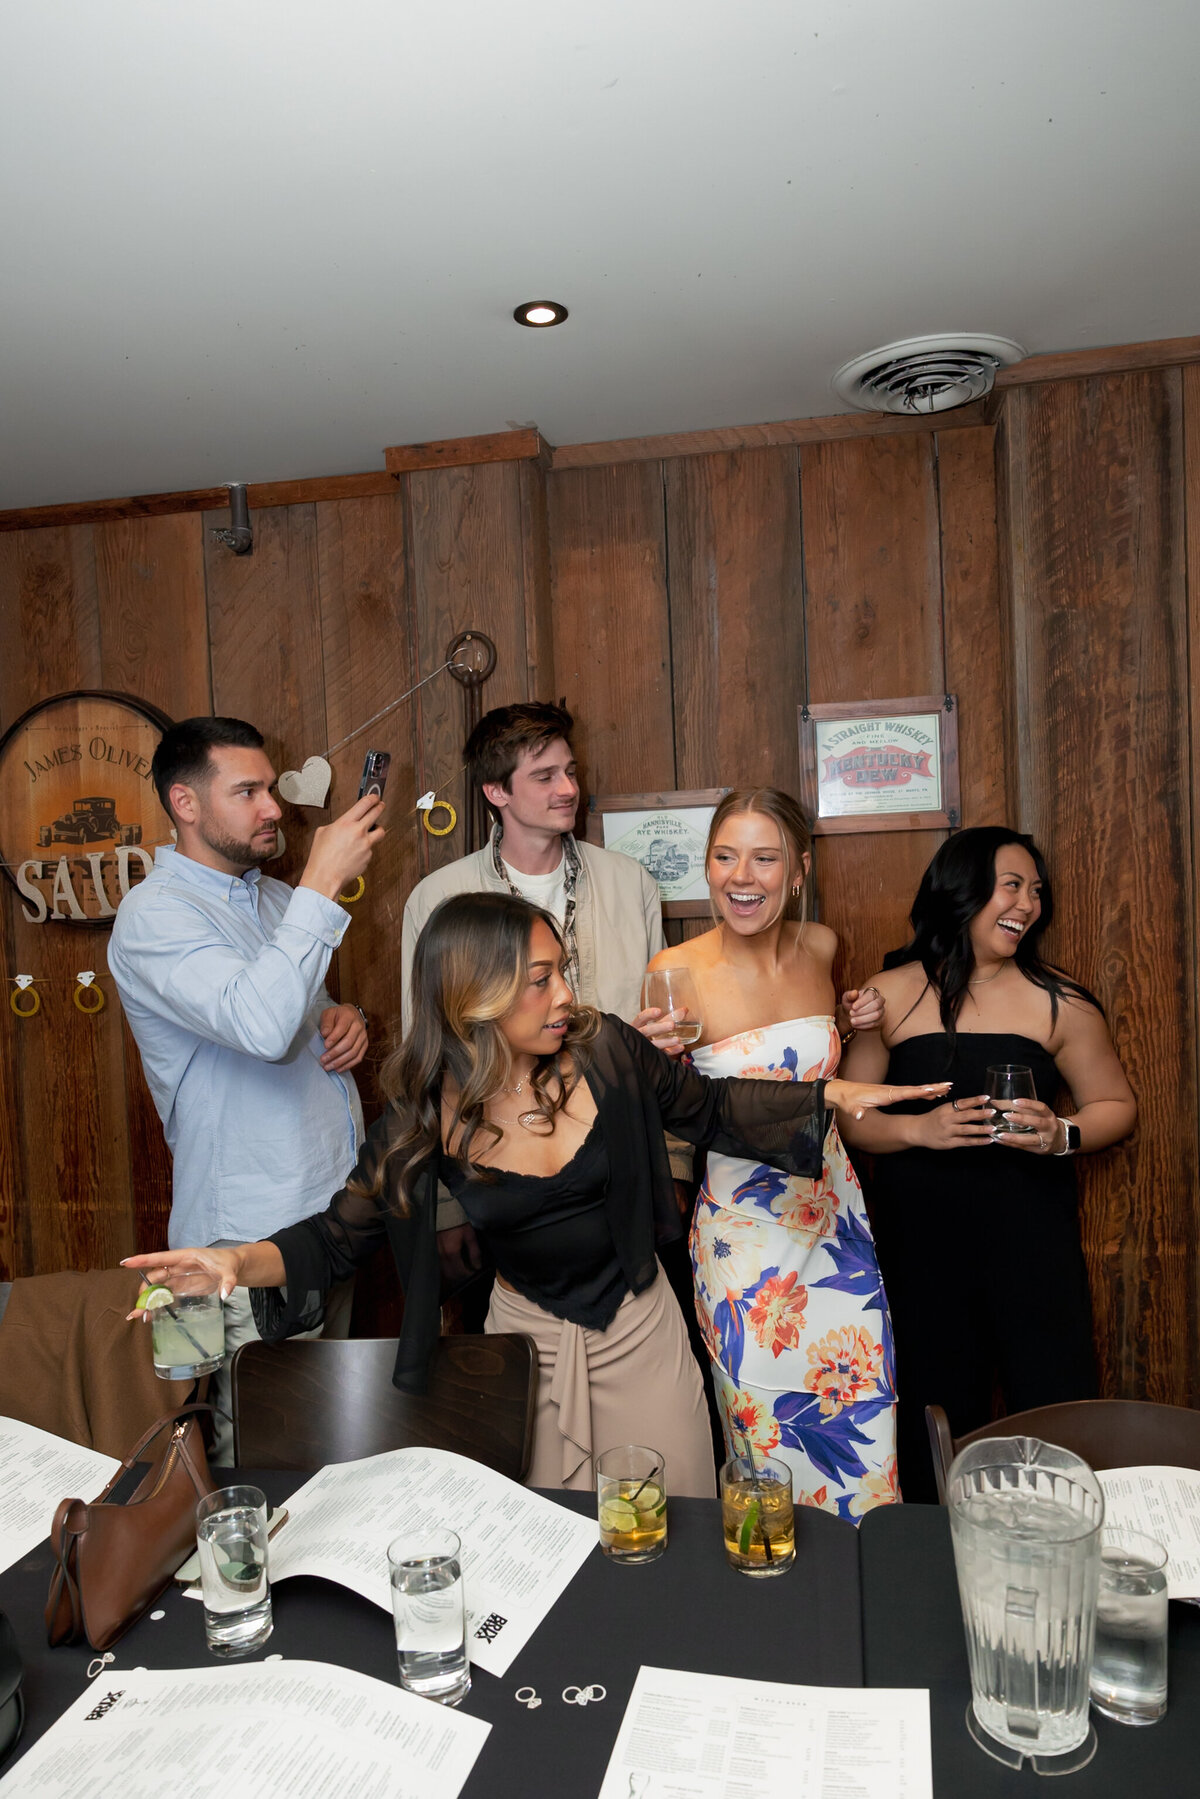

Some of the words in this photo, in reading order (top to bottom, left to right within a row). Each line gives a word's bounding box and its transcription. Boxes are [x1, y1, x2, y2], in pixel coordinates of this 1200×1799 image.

[827, 721, 882, 746] STRAIGHT
[884, 721, 934, 747] WHISKEY
[822, 743, 834, 751] A
[23, 744, 83, 783] JAMES
[829, 752, 927, 779] KENTUCKY
[855, 767, 899, 783] DEW
